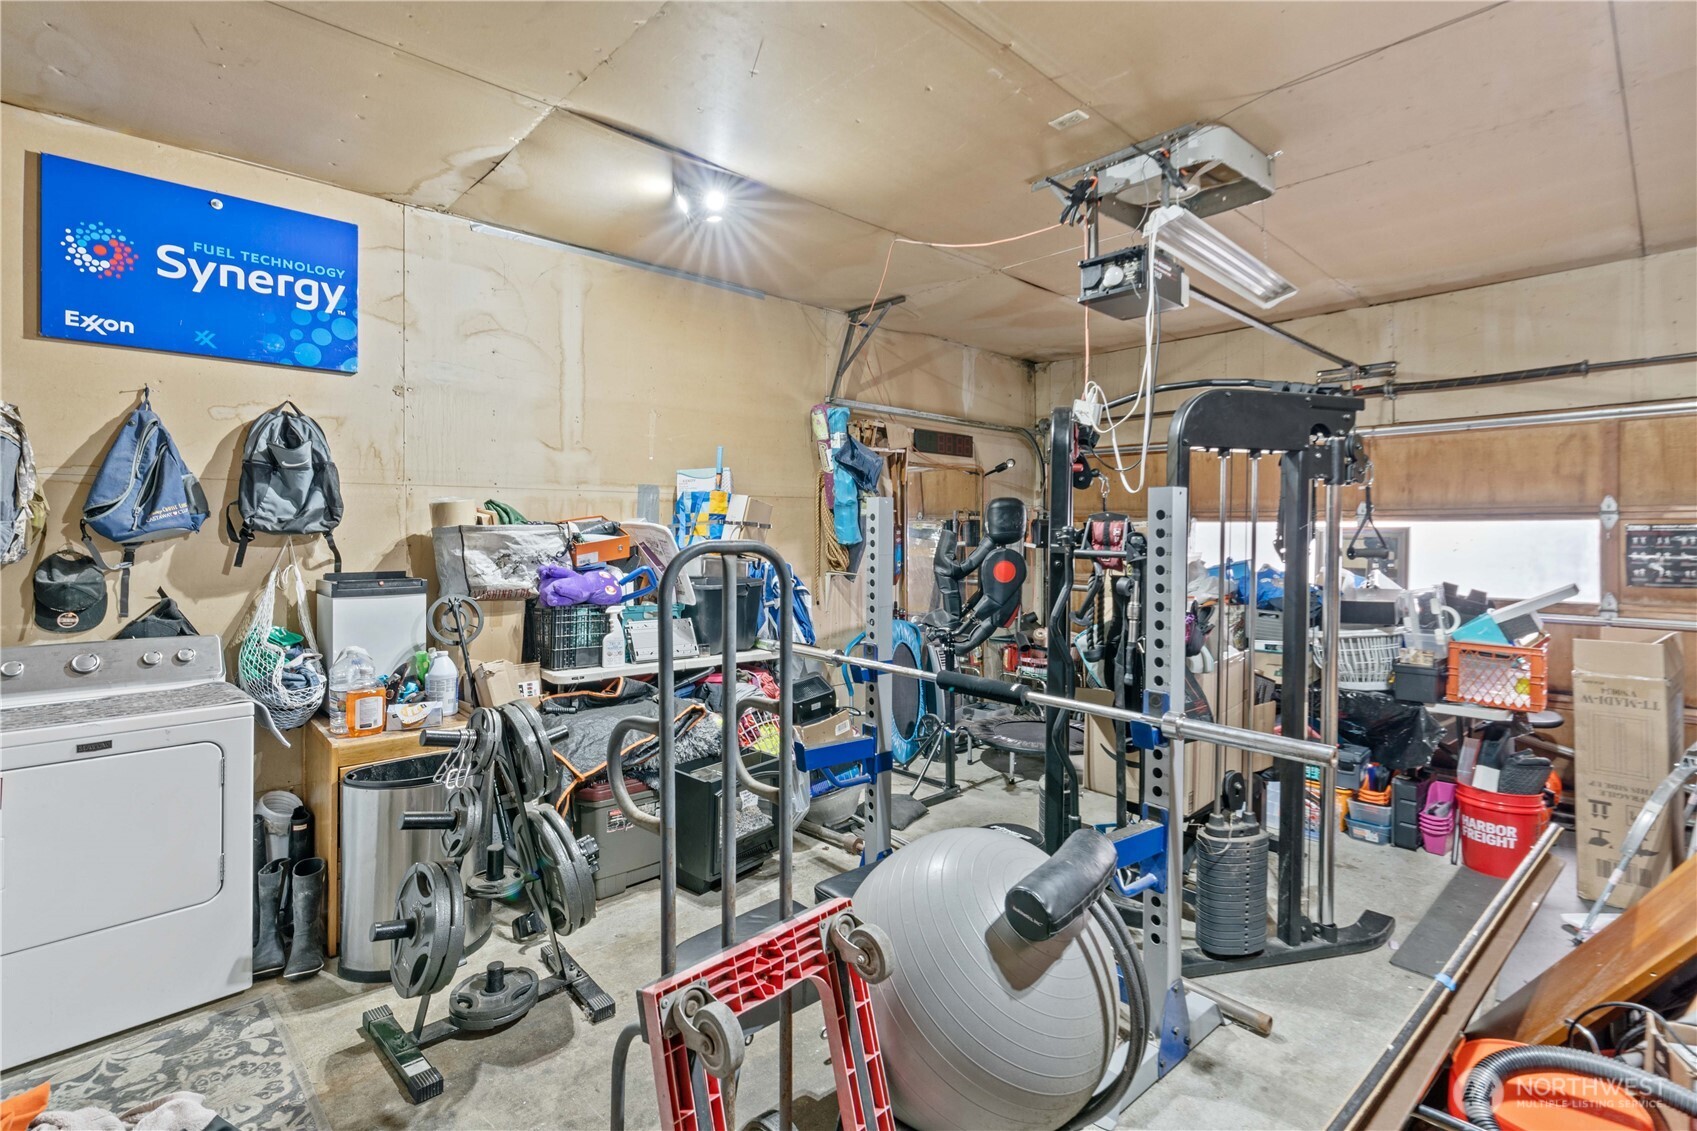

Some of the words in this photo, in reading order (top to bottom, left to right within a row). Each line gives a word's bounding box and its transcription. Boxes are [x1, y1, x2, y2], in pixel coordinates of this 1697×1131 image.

[194, 242, 235, 259] FUEL
[242, 250, 346, 279] TECHNOLOGY
[156, 244, 346, 315] Synergy
[65, 309, 135, 336] Exxon
[1462, 814, 1518, 838] HARBOR
[1462, 825, 1518, 849] FREIGHT
